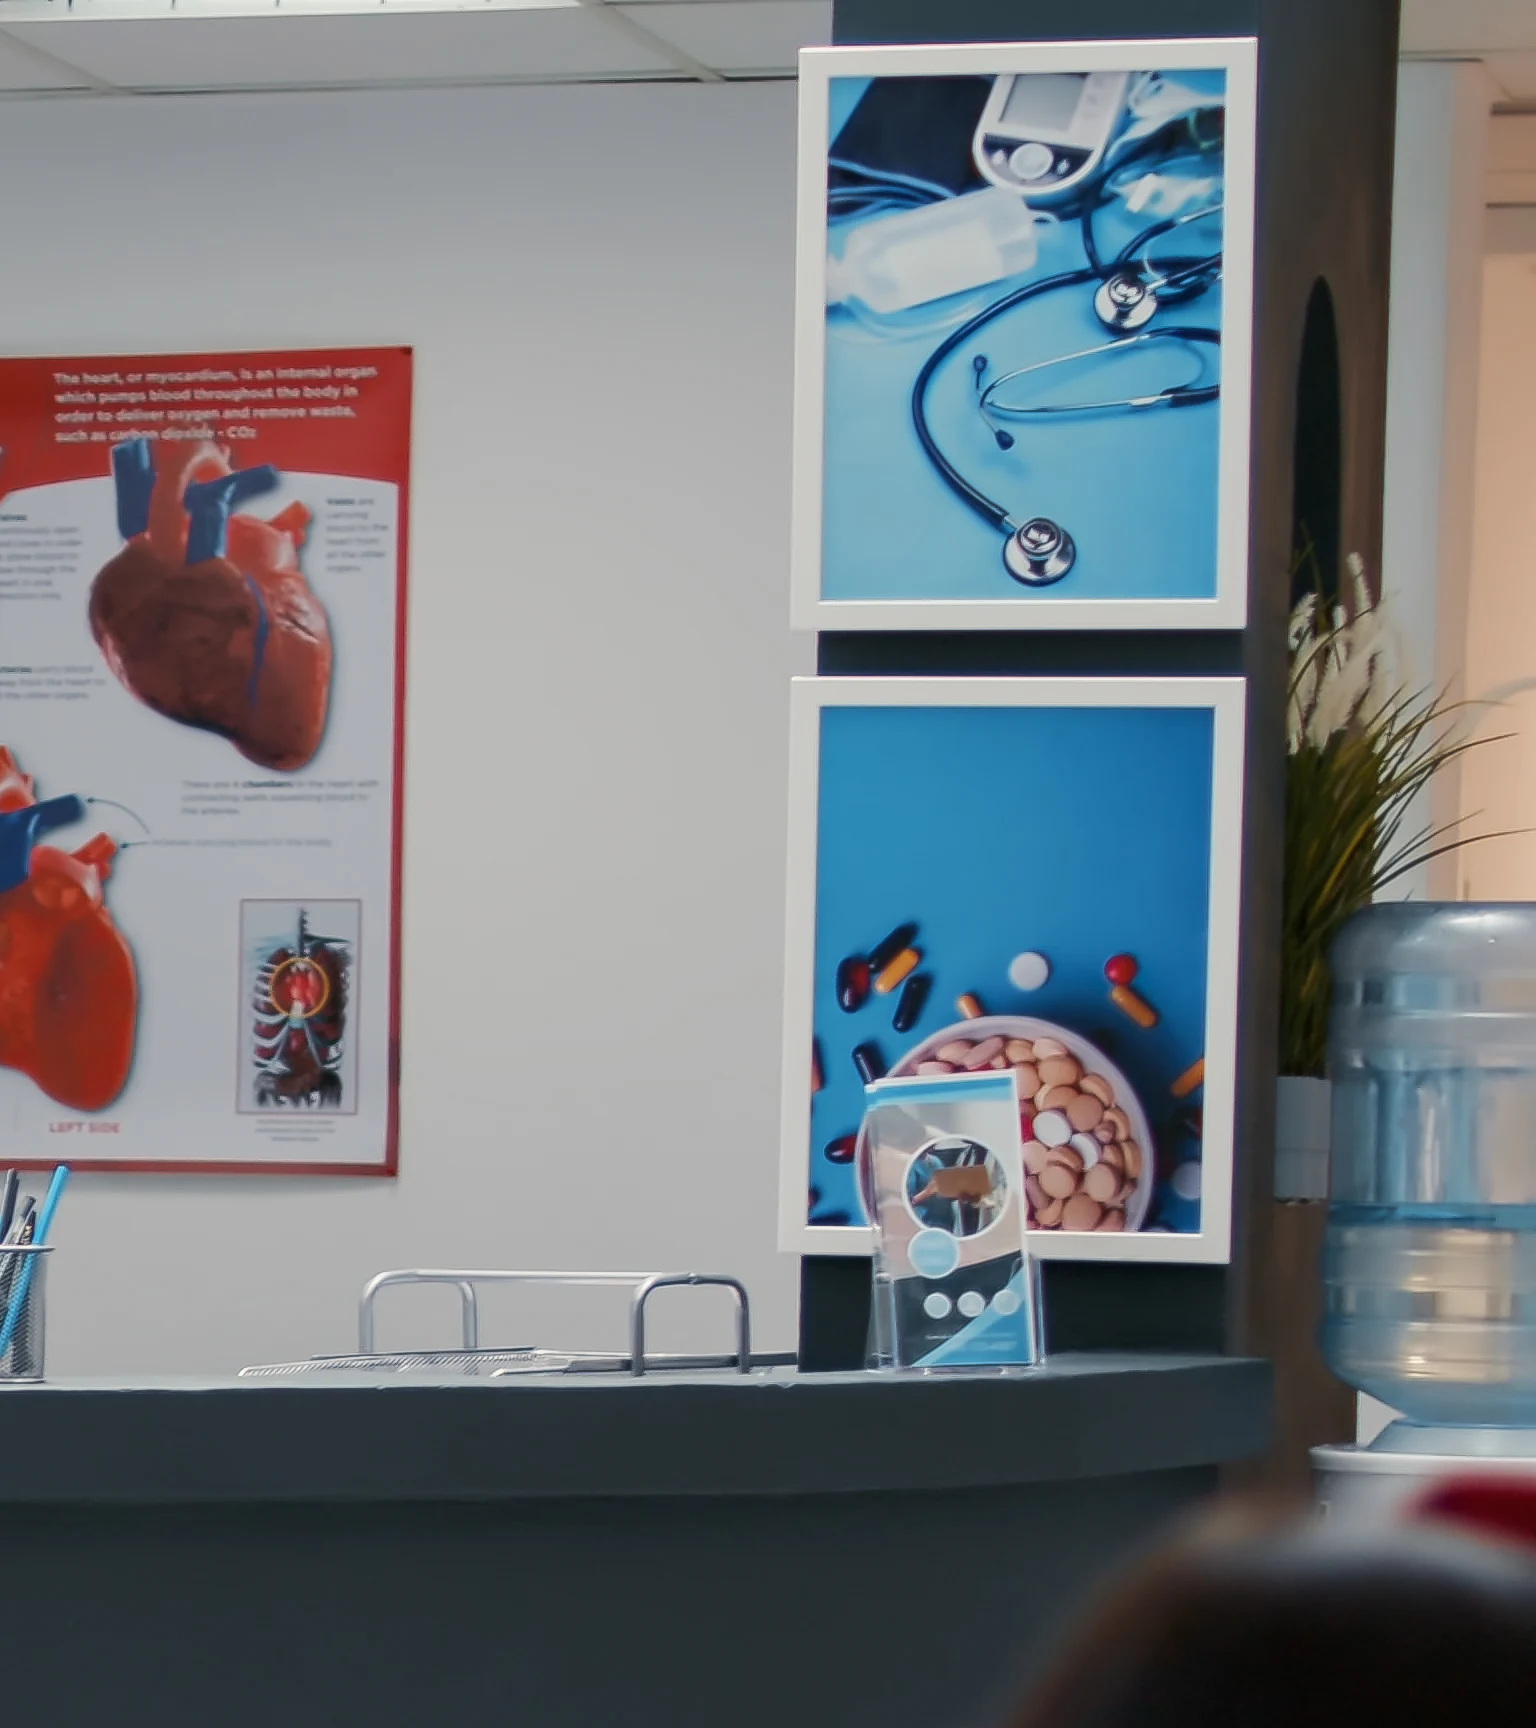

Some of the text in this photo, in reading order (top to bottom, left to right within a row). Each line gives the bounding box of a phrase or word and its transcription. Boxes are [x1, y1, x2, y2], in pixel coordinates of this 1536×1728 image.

[52, 371, 80, 384] The
[126, 373, 143, 383] or
[256, 369, 274, 380] an
[276, 365, 331, 379] internal
[333, 367, 378, 380] organ
[54, 385, 359, 404] which pumps blood throughout the body in
[54, 410, 94, 423] order
[98, 411, 113, 422] to
[116, 408, 164, 422] deliver
[166, 409, 221, 423] oxygen
[223, 406, 251, 419] and
[252, 407, 306, 419] remove
[49, 1122, 121, 1133] LEFT SIDE
